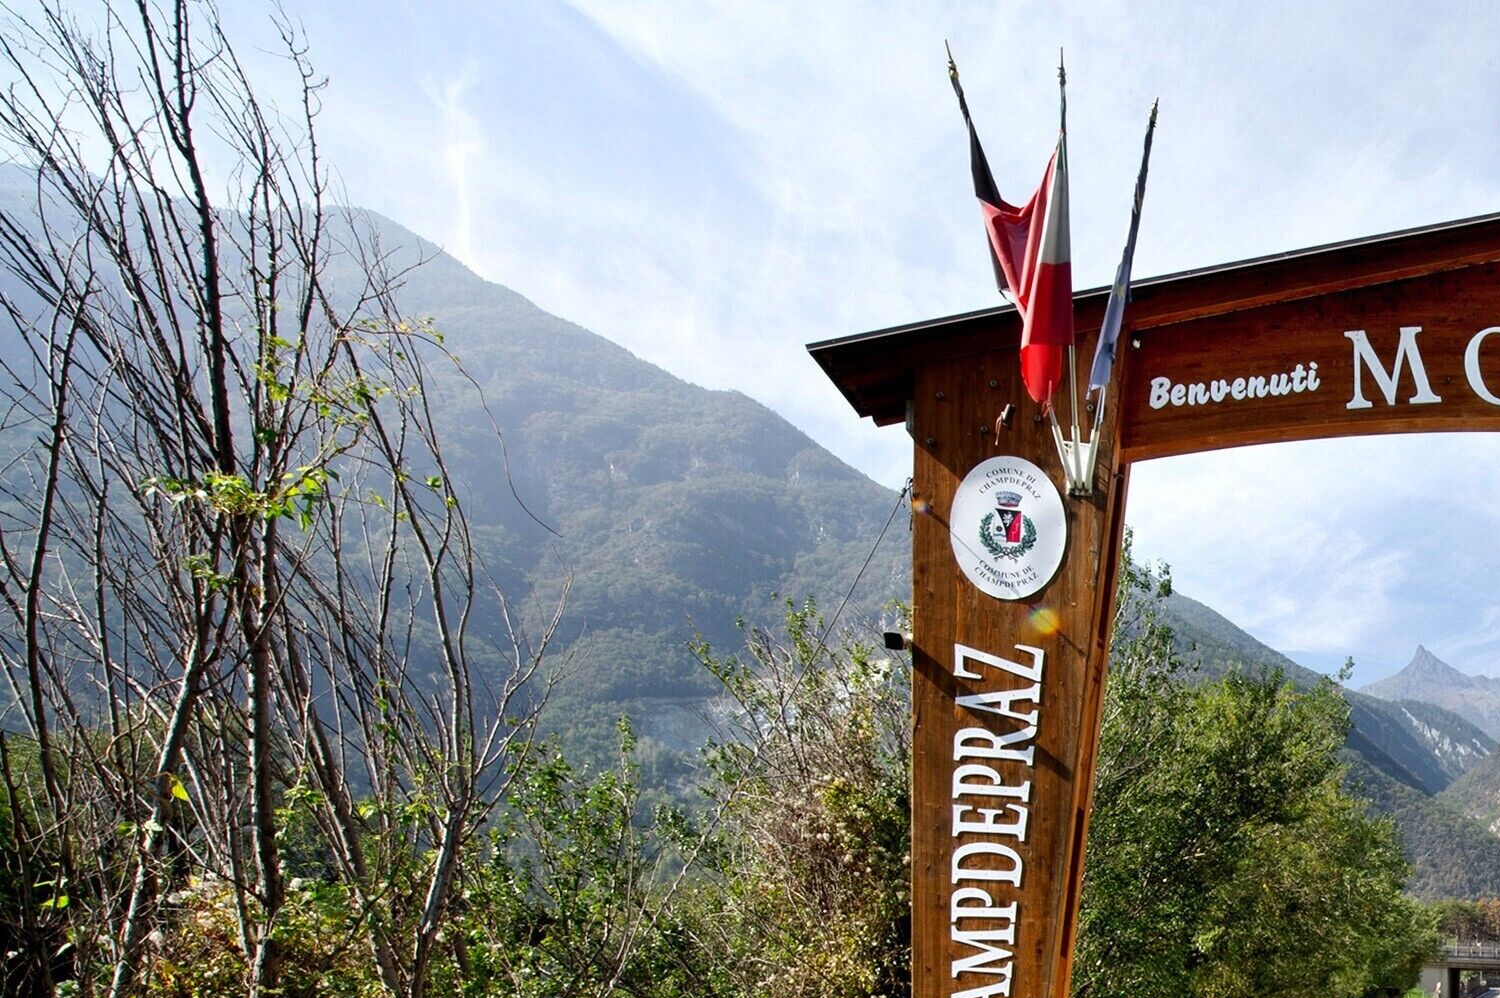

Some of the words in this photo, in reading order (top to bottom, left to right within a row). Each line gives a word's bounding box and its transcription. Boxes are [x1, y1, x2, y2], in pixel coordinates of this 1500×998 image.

[1149, 361, 1321, 410] Benvenuti
[986, 468, 1024, 478] COMUNE
[1026, 474, 1036, 483] DI
[979, 477, 1041, 500] CHAMPDEPRAZ
[975, 566, 1039, 588] CHAMPDEPRAZ
[980, 560, 1020, 579] COMMUNE
